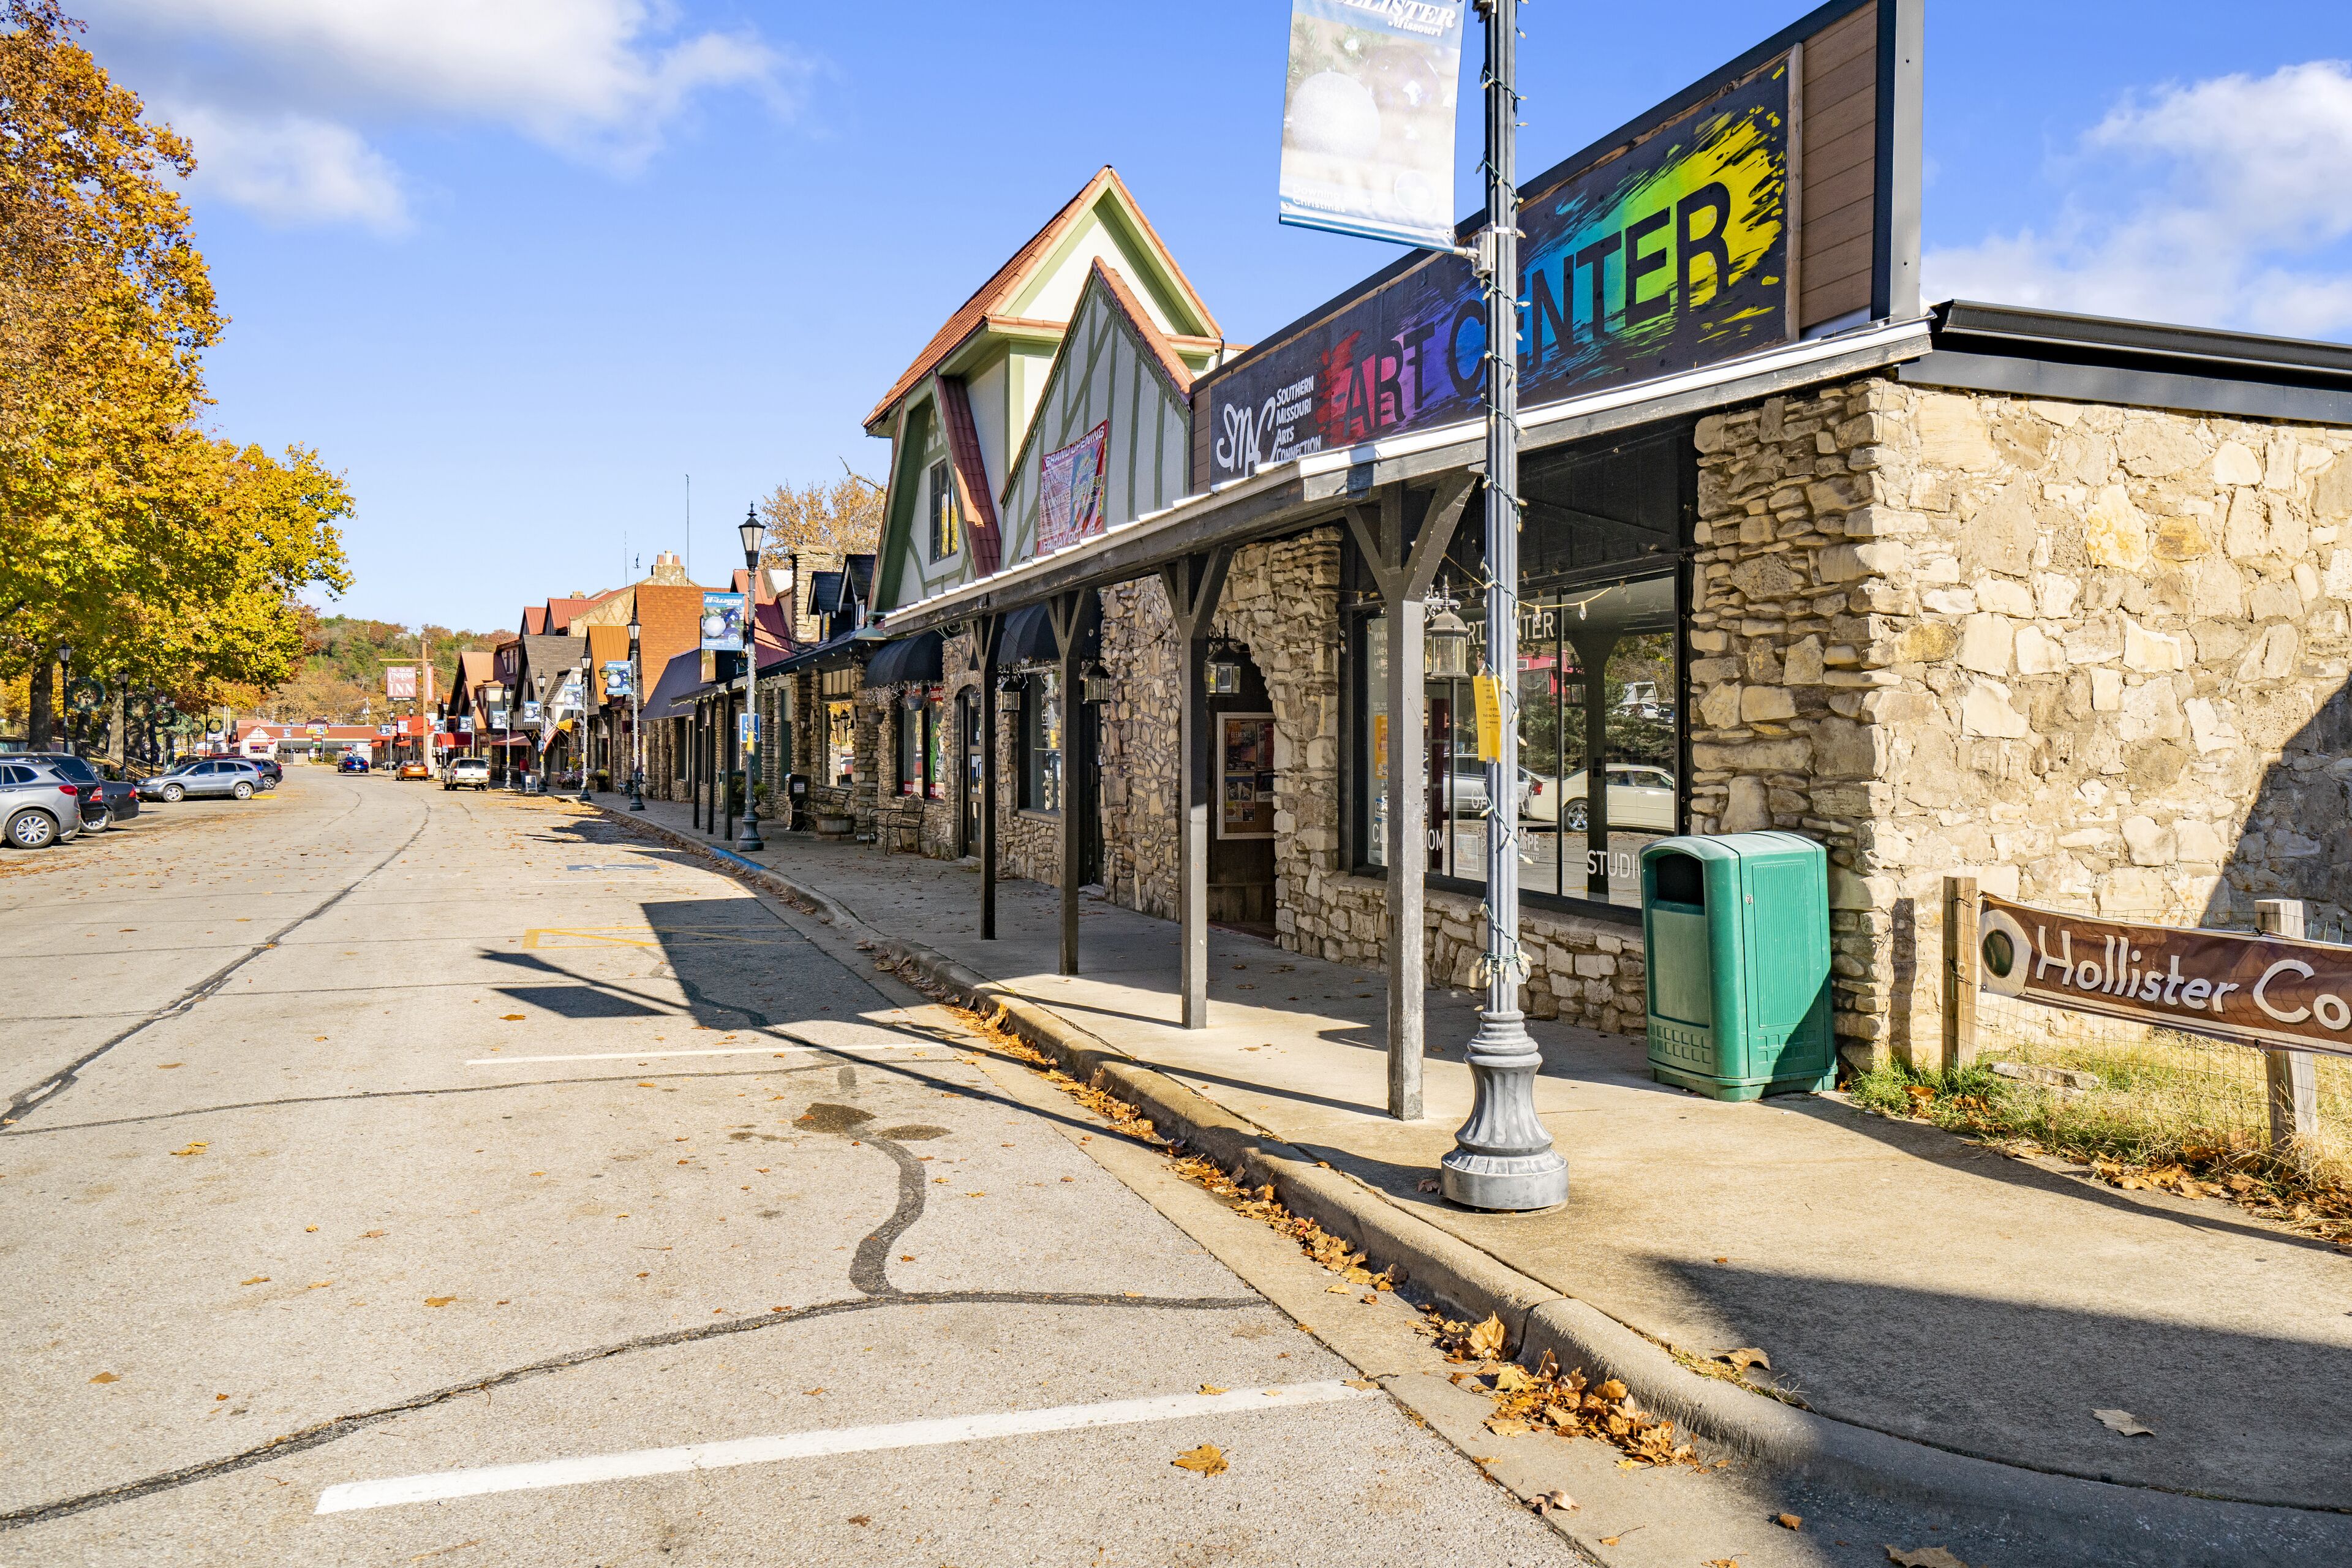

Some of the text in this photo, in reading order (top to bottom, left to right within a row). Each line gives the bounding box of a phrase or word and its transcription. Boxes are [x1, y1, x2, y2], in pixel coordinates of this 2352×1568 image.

[1387, 17, 1442, 37] Missouri
[1293, 184, 1340, 202] Downing
[1293, 196, 1346, 213] Christmas
[1276, 375, 1314, 407] SOUTHERN
[1343, 321, 1436, 436] ART
[1276, 398, 1311, 426] MISSOURI
[1046, 449, 1070, 467] GRAND
[1071, 425, 1104, 454] OPENING
[1276, 425, 1295, 447] ARTS
[1276, 435, 1321, 461] CONNECTION
[1043, 534, 1068, 552] FRIDAY
[1087, 522, 1095, 537] 12
[1467, 620, 1485, 646] RT
[1374, 646, 1384, 655] Like
[390, 683, 413, 696] INN
[1471, 788, 1535, 813] GARY
[1587, 850, 1640, 879] STUDI
[2035, 925, 2351, 1030] Hollister Co
